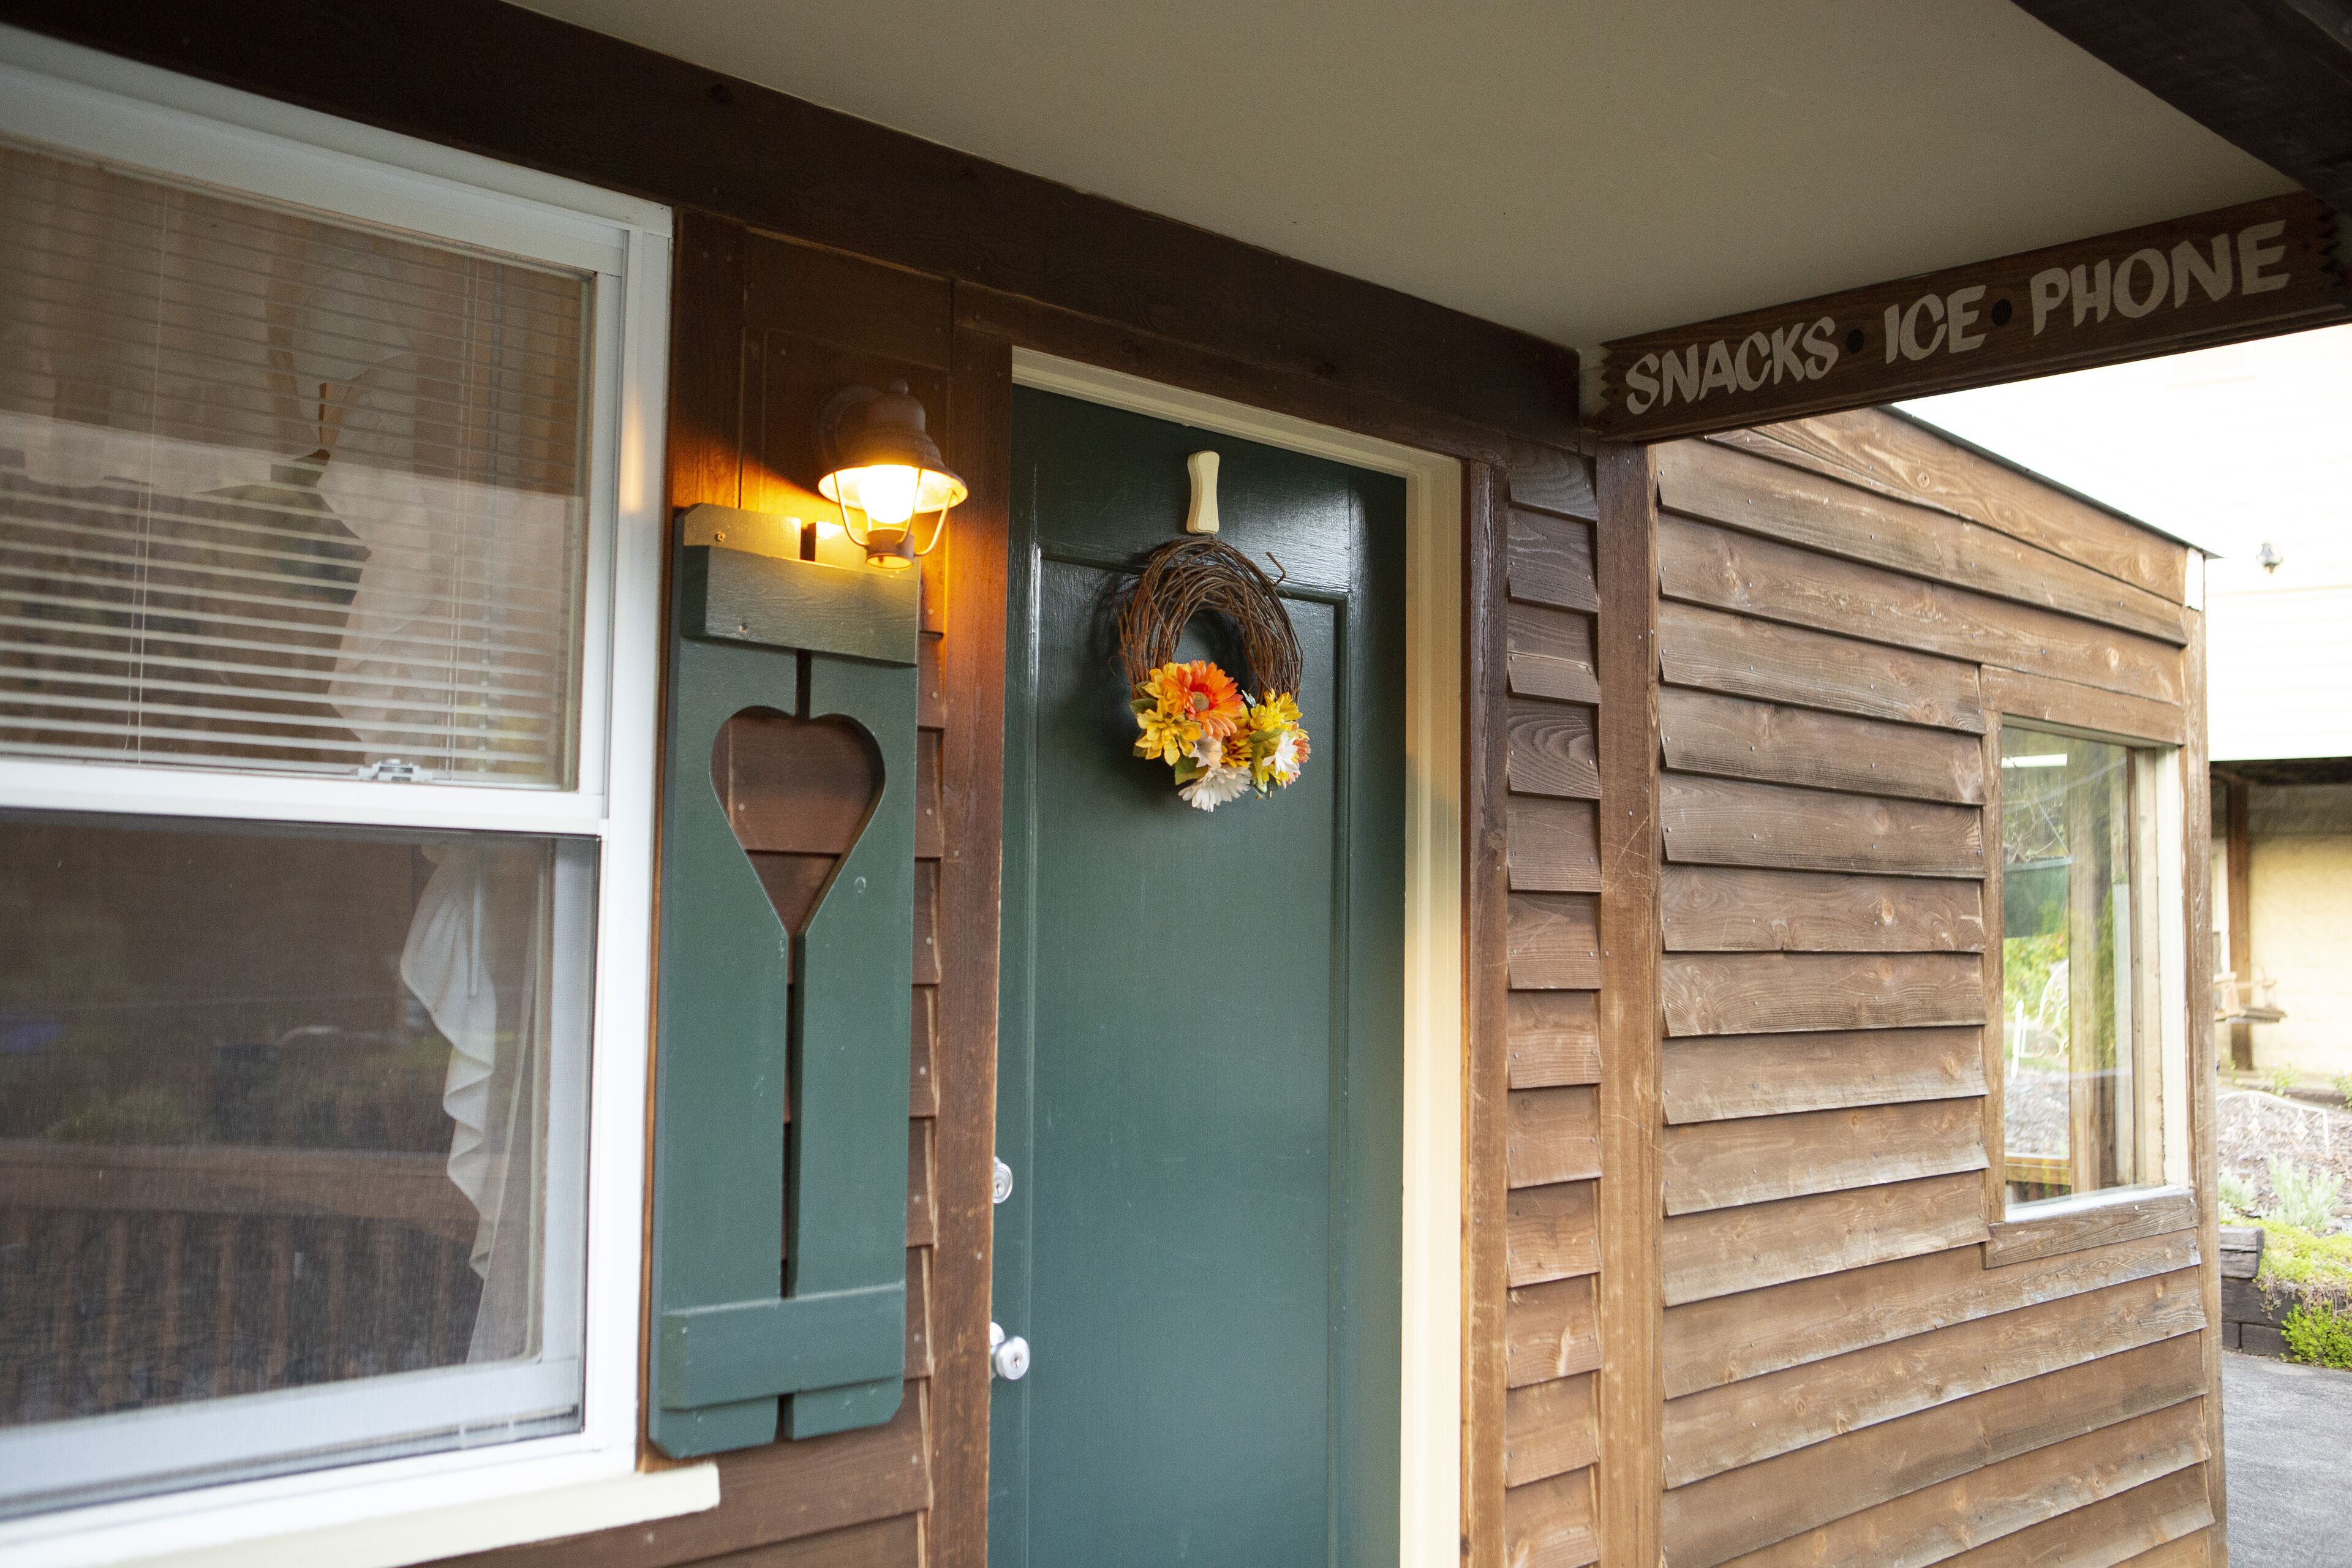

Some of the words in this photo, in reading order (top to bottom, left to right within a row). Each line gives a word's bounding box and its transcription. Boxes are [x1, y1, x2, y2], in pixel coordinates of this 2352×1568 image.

[1626, 317, 1839, 415] SNACKS
[1885, 285, 1988, 364] ICE
[2030, 219, 2291, 336] PHONE
